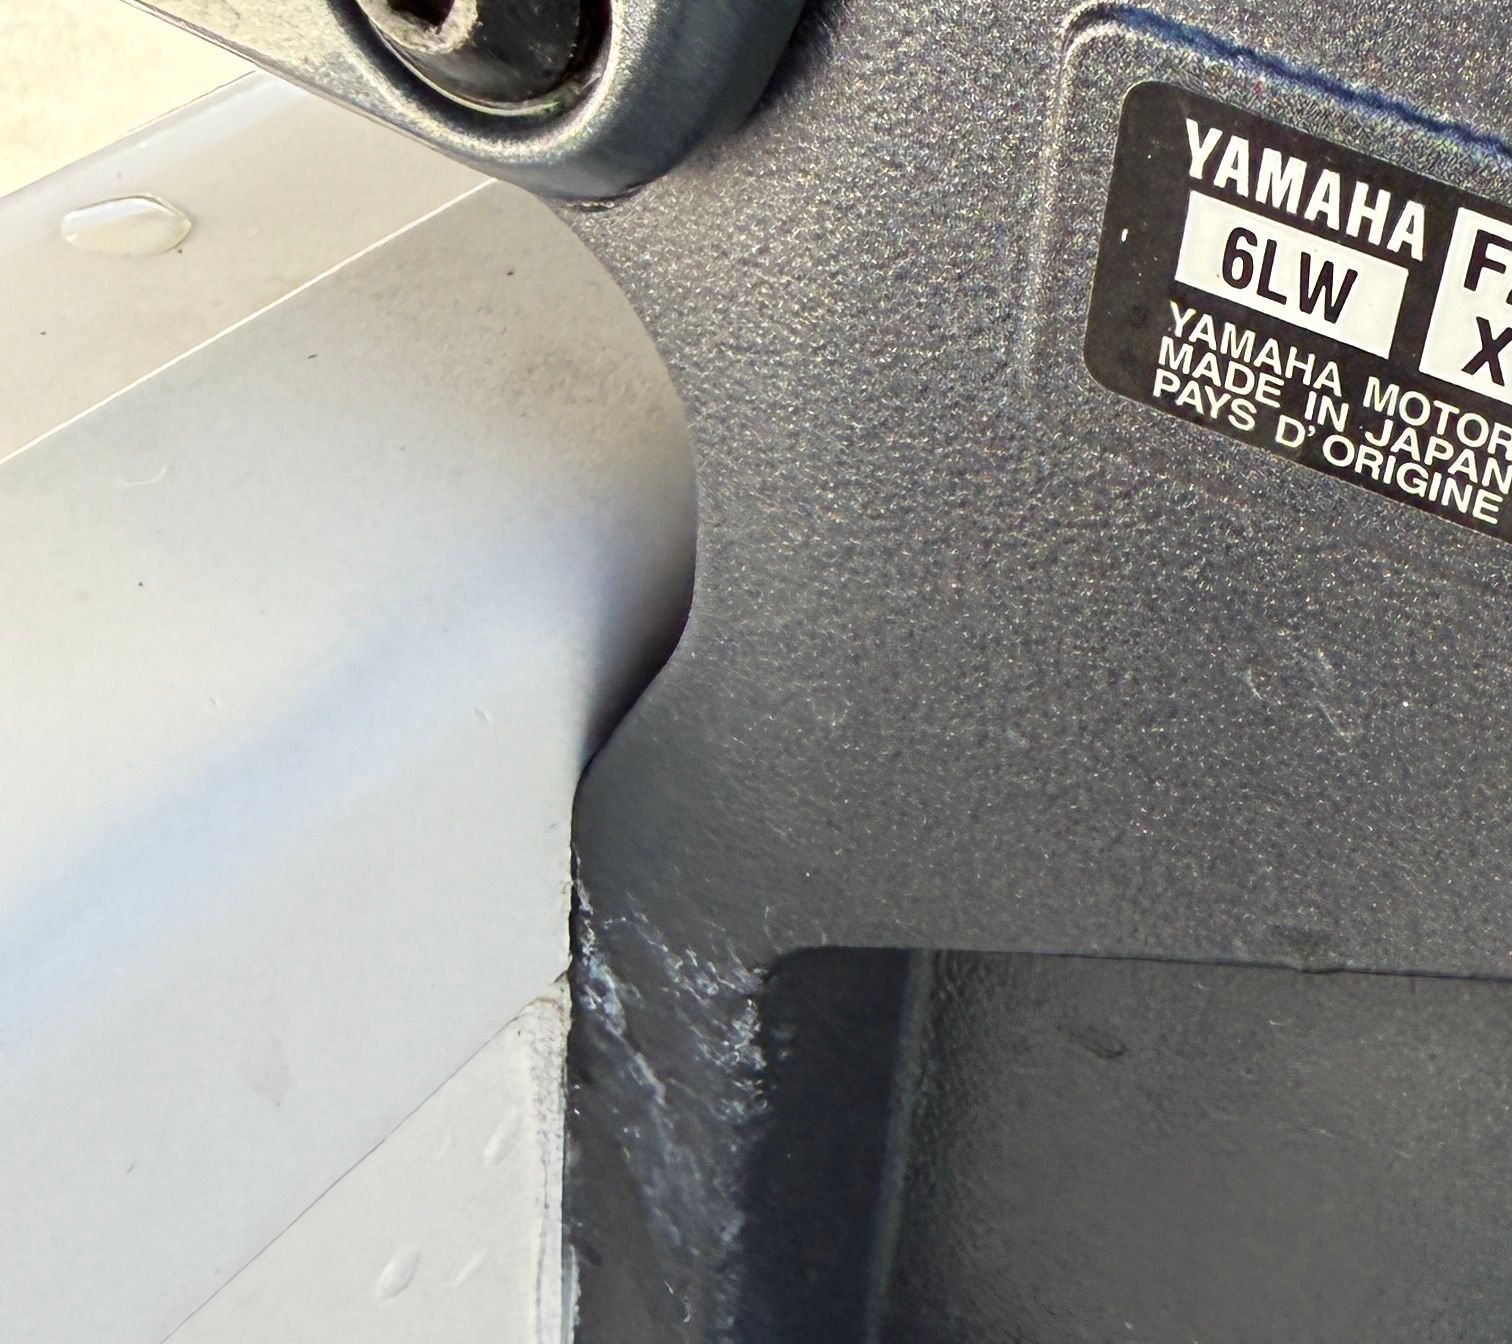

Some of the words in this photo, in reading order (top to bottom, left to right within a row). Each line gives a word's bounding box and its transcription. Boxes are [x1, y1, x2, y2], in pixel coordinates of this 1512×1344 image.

[1184, 117, 1427, 262] YAMAHA
[1220, 226, 1359, 325] 6LW
[1159, 337, 1284, 409] MADE
[1303, 389, 1348, 433] IN
[1169, 301, 1343, 397] YAMAHA
[1154, 367, 1257, 432] PAYS
